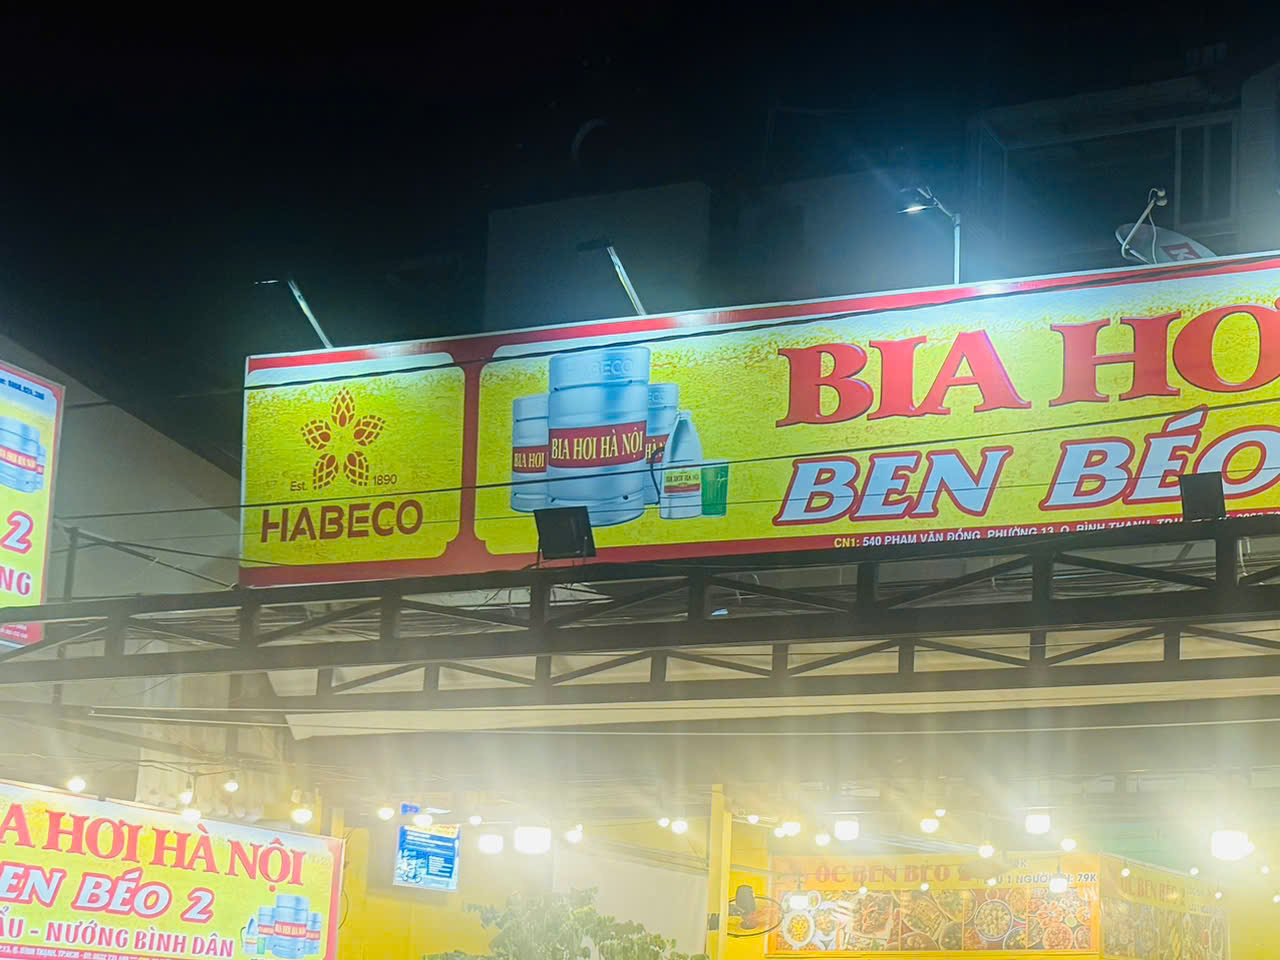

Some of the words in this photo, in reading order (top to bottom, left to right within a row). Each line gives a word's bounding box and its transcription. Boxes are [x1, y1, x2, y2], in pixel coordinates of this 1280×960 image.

[776, 330, 1031, 428] BIA
[551, 436, 571, 460] BIA
[573, 436, 597, 460] HƠI
[600, 428, 619, 459] HÀ
[622, 427, 644, 458] NỘI
[290, 480, 307, 491] Est.
[373, 474, 397, 486] 1890
[773, 445, 1013, 526] BEN
[0, 510, 34, 555] 2
[261, 500, 424, 543] HABECO
[834, 536, 860, 549] CN1:
[863, 535, 882, 547] 540
[42, 810, 143, 863] HƠI
[150, 824, 220, 874] HÀ
[224, 837, 306, 892] NỘI
[72, 867, 172, 919] BÉO
[181, 887, 215, 924] 2
[1077, 872, 1097, 883] 79K
[46, 920, 129, 948] NƯỚNG
[134, 926, 187, 954] BÌNH
[192, 932, 234, 958] DÂN
